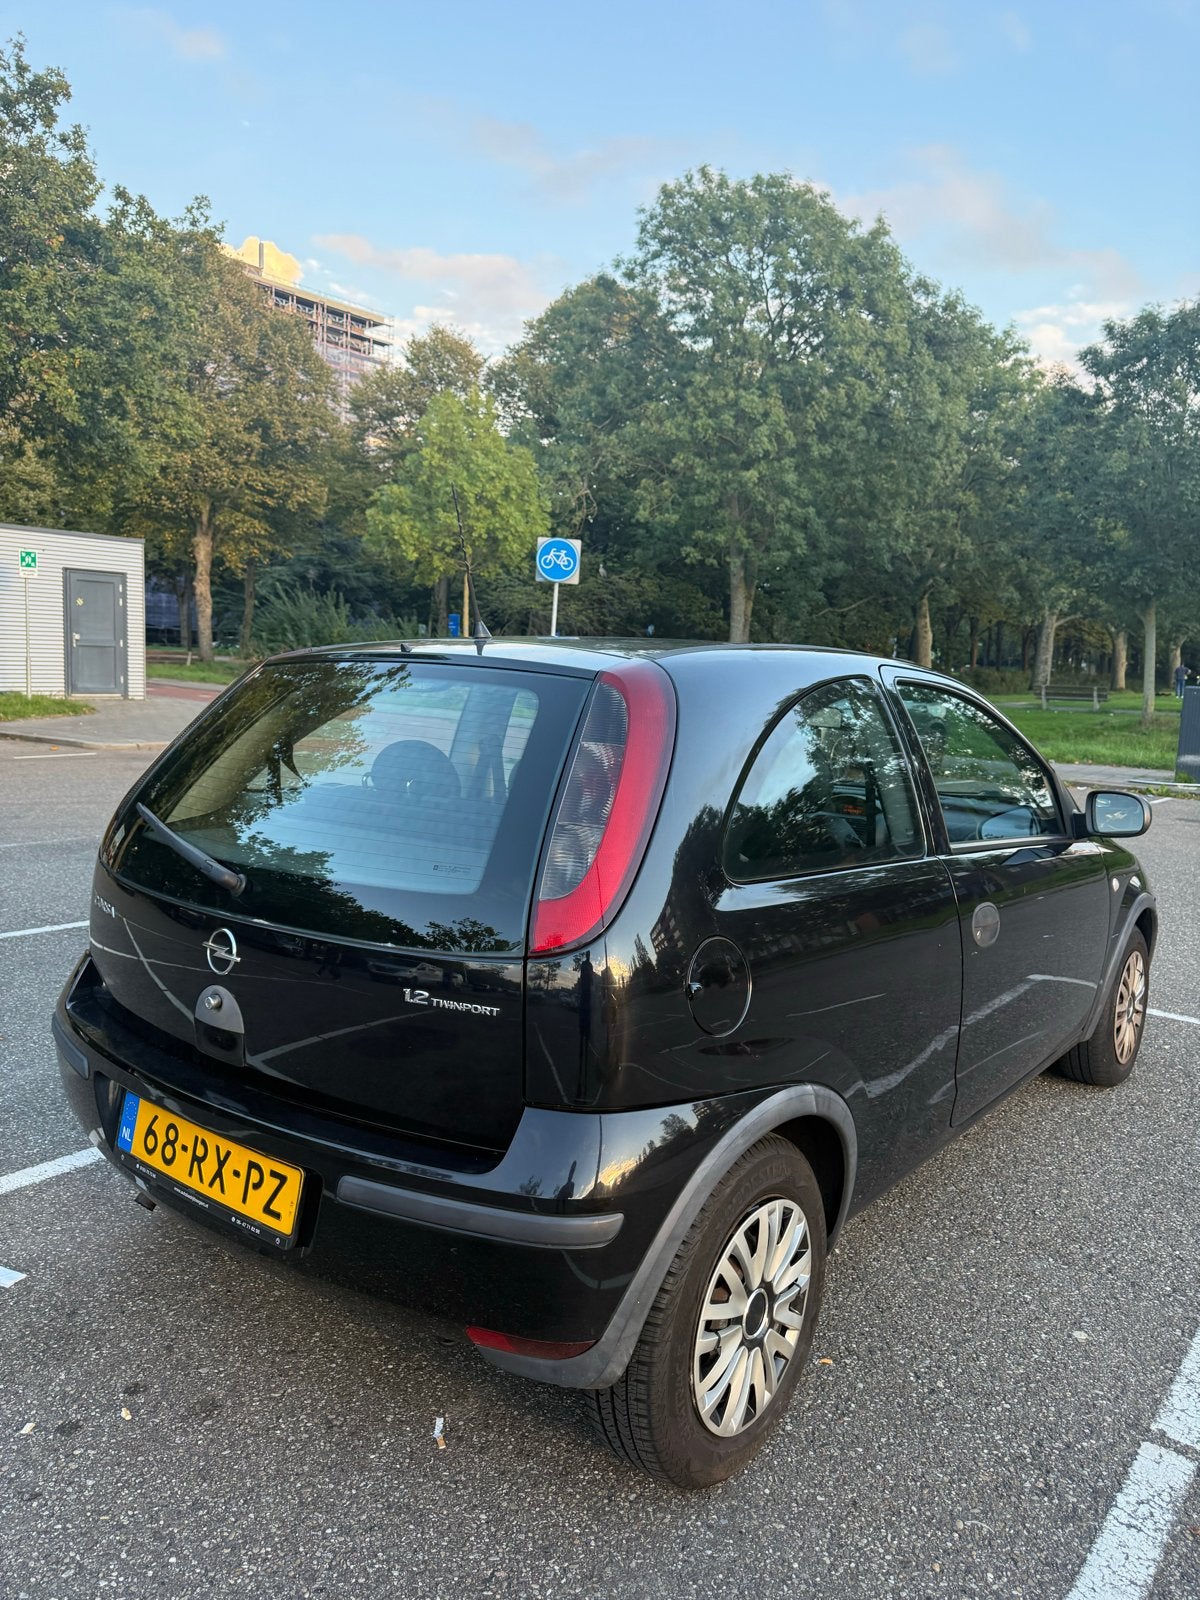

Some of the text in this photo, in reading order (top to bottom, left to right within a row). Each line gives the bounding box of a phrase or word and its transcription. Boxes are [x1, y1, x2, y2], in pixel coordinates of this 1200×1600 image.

[431, 997, 500, 1017] TWINPORT
[121, 1126, 132, 1142] NL
[143, 1114, 289, 1222] 68-RX-PZ
